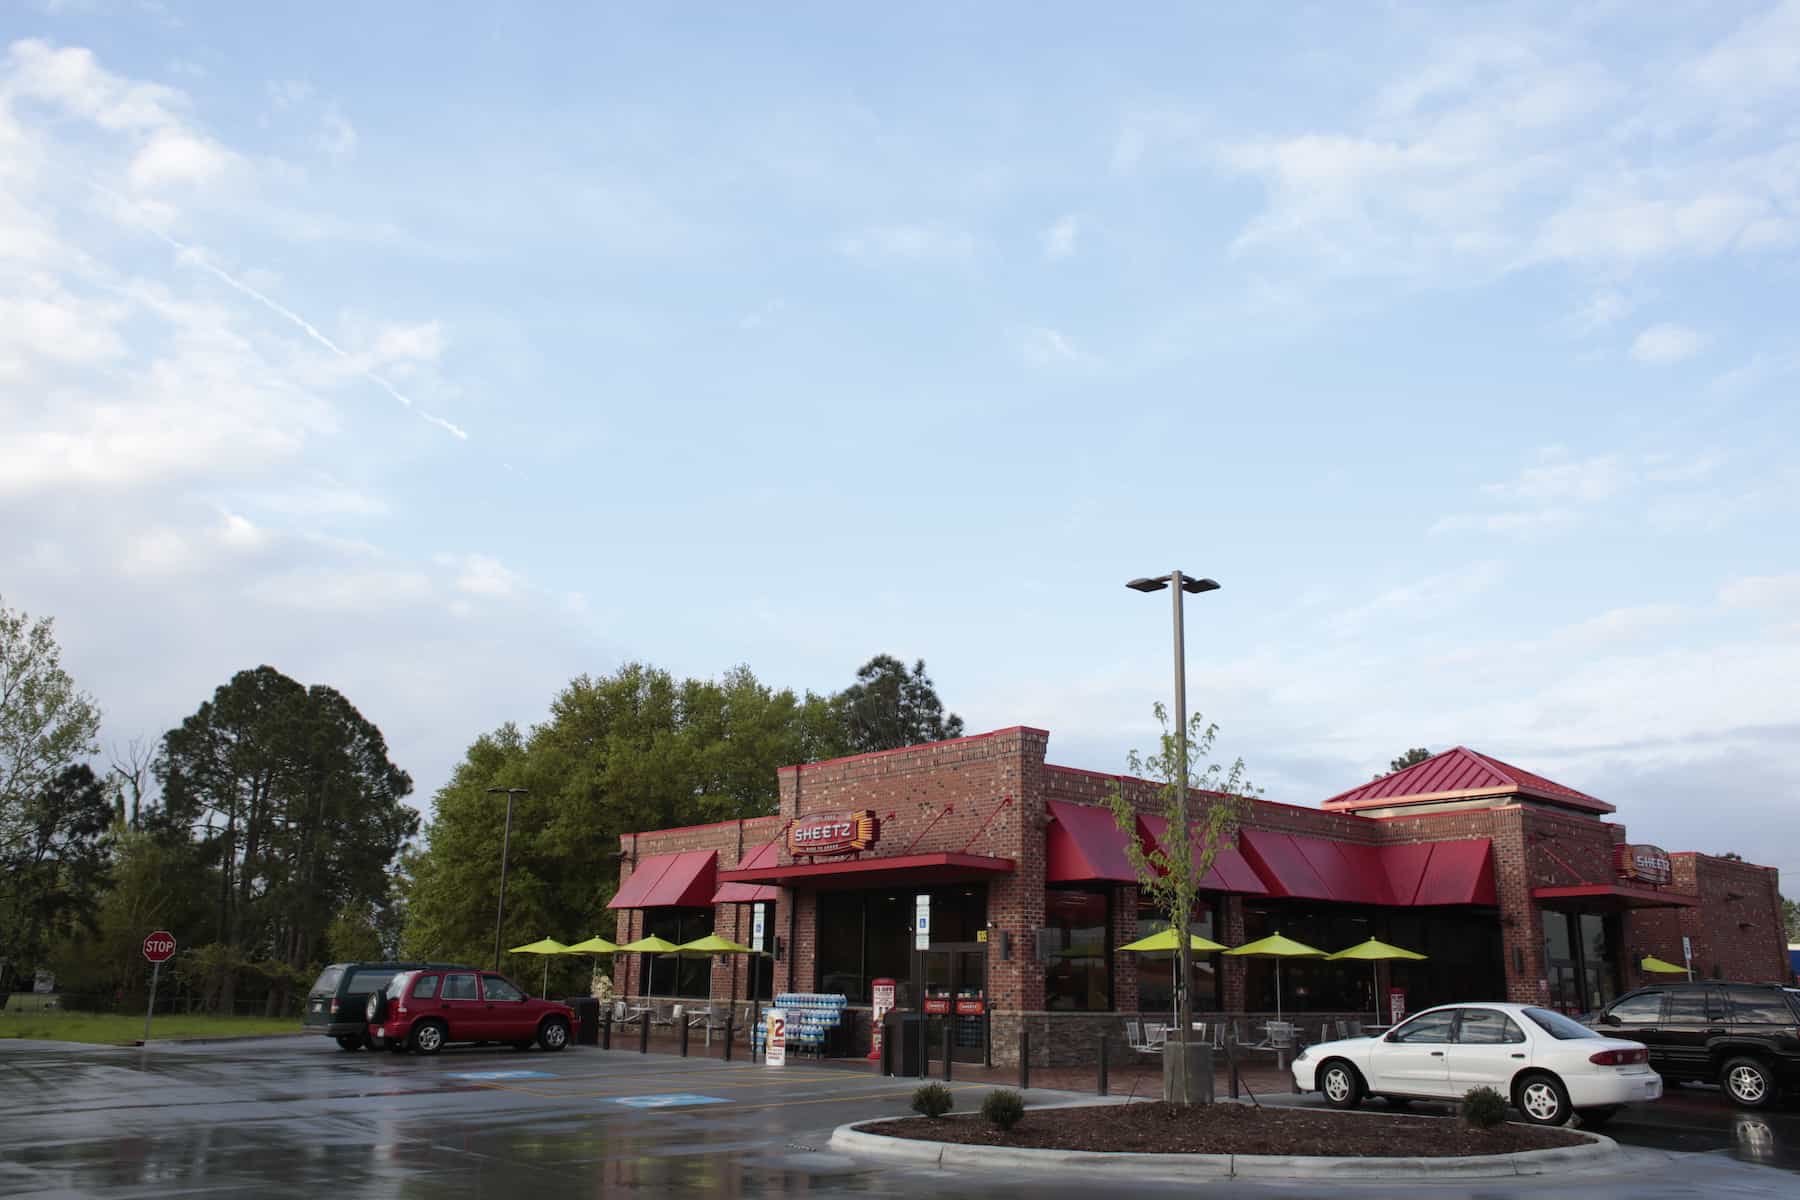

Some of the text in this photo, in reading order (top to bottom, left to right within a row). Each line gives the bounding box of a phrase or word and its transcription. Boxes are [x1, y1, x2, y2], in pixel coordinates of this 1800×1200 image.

[795, 823, 850, 842] SHEETZ
[146, 941, 173, 952] STOP
[775, 1019, 784, 1036] 2
